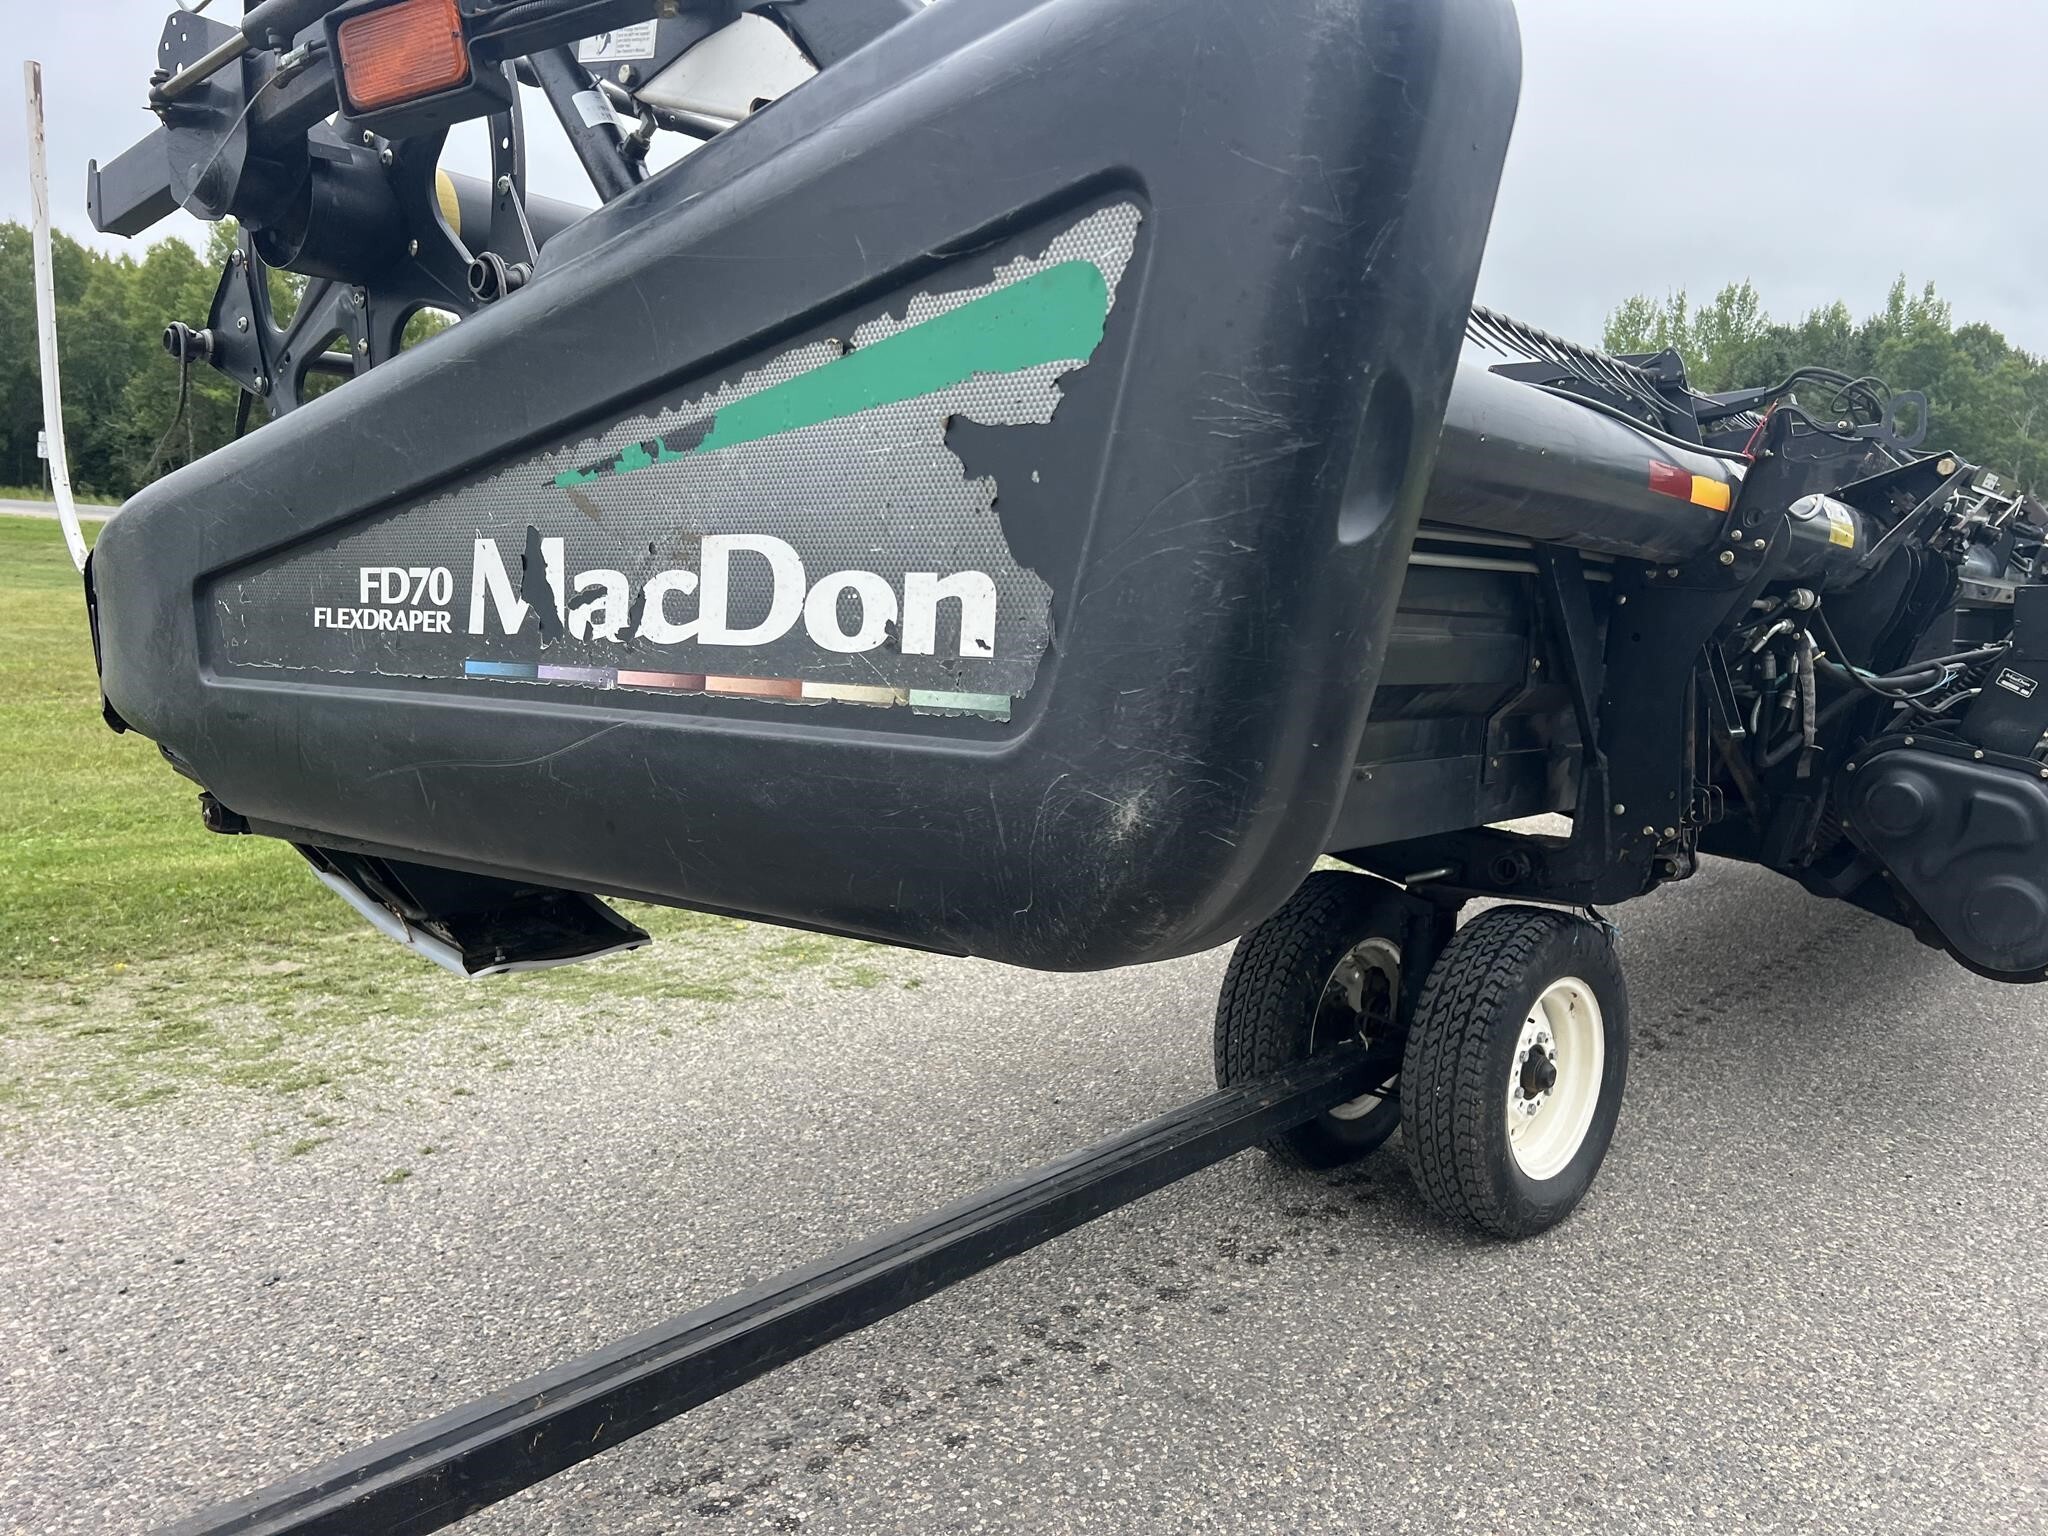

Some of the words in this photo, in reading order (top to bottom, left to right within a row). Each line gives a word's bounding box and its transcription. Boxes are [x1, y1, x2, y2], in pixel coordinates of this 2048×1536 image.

[360, 567, 453, 606] FD70
[468, 534, 997, 658] MacDon
[314, 607, 452, 634] FLEXDRAPER
